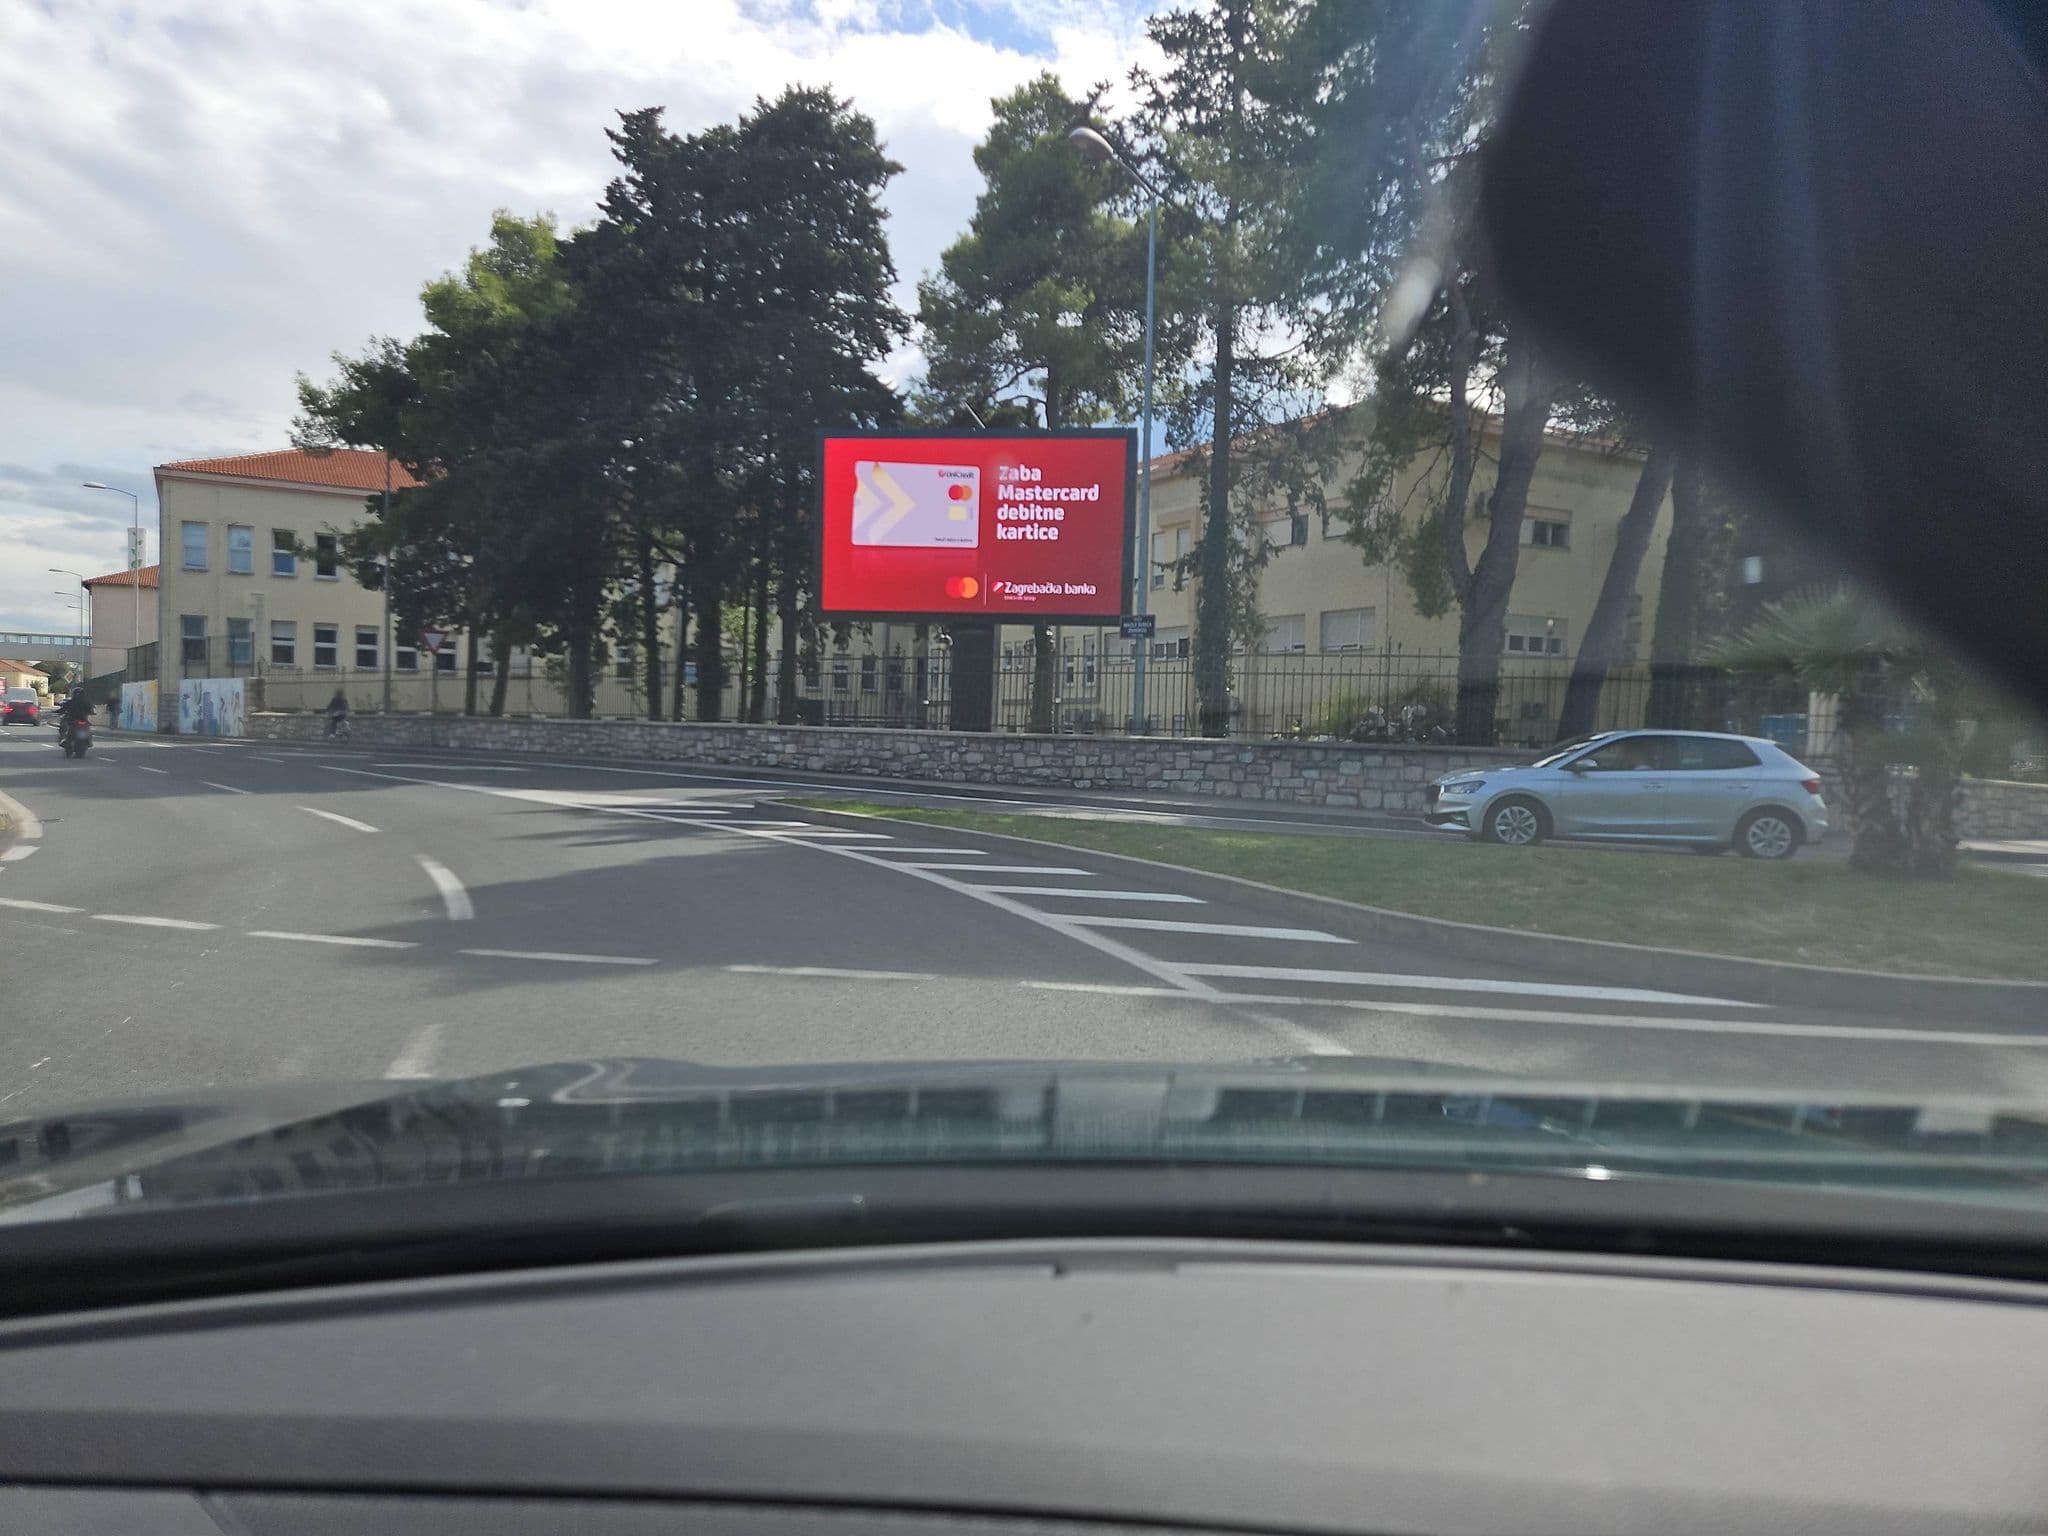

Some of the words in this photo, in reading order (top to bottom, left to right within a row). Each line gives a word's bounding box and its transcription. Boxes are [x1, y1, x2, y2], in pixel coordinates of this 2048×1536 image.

[997, 483, 1100, 501] Mastercard
[997, 503, 1065, 521] debitne
[996, 522, 1059, 540] kartice
[1064, 583, 1097, 595] banka
